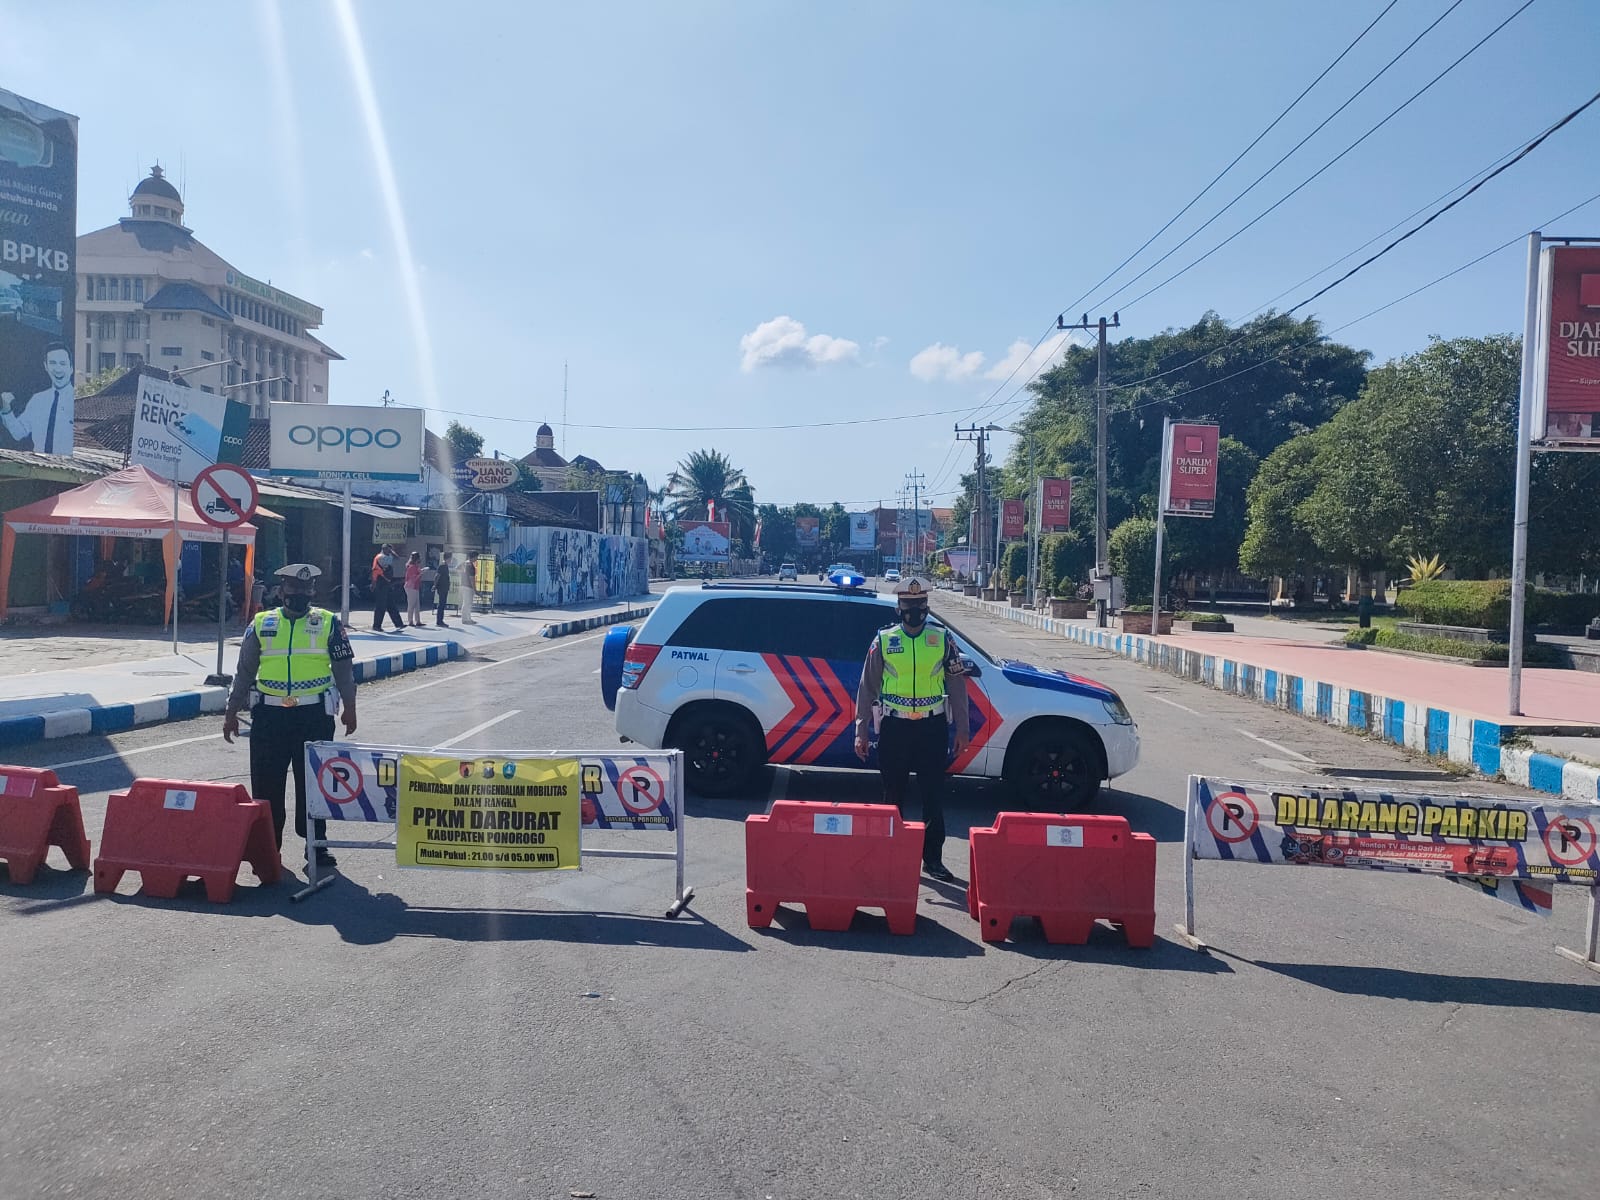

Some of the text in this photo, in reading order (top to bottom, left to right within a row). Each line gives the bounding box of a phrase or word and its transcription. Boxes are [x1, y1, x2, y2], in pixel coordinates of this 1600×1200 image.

[3, 239, 69, 272] BPKB
[223, 435, 243, 447] oppo
[288, 425, 402, 453] oppo
[137, 437, 182, 456] OPPO Reno5
[1176, 457, 1213, 467] DJARUM
[318, 471, 370, 480] MONICA CELL
[480, 467, 512, 476] UANG
[1179, 465, 1208, 475] SUPER
[477, 475, 509, 484] ASING
[671, 650, 709, 661] PATWAL
[408, 780, 568, 797] PEMBATASAN DAN PENGENDALIAN MOBILITAS
[453, 796, 517, 808] DALAM RANGKA
[413, 806, 562, 831] PPKM DARURAT
[637, 815, 670, 825] PONOROGO
[1275, 793, 1528, 842] DILARANG PARKIR
[427, 828, 545, 845] KABUPATEN PONOROGO
[1360, 841, 1386, 849] Nonton
[1418, 844, 1433, 852] Dari
[420, 848, 443, 859] Mulai
[443, 849, 467, 861] Pukul
[472, 851, 494, 861] 21.00
[495, 852, 510, 863] s/d
[511, 853, 535, 863] 05.00
[536, 853, 555, 863] WIB
[1526, 864, 1598, 879] SATLANTAS PONOROGO
